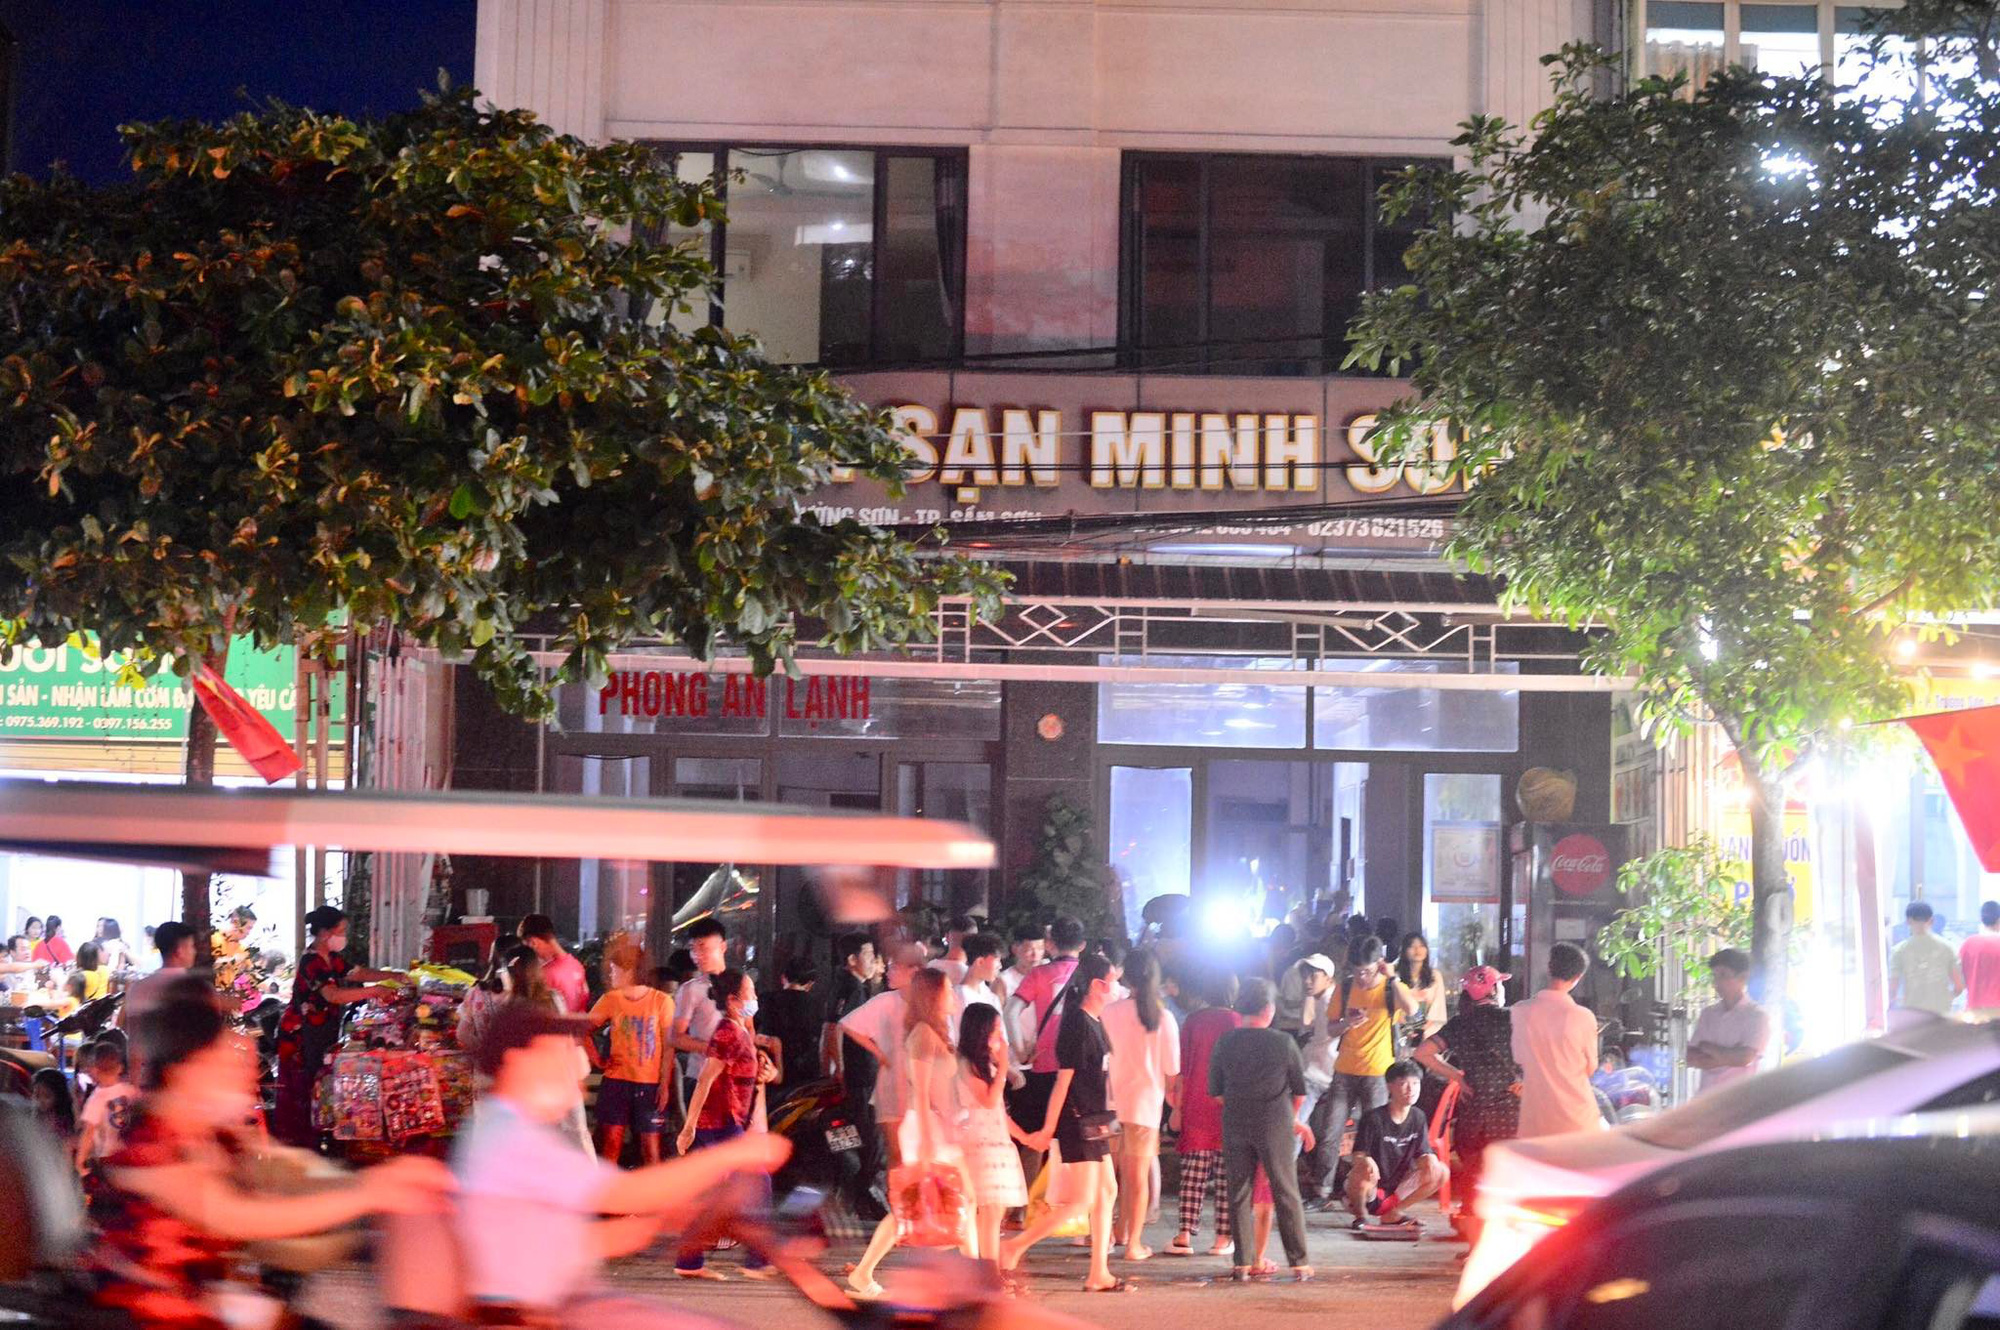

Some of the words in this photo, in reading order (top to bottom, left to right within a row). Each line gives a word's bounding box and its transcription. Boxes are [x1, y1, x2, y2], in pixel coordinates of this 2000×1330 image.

[888, 404, 1062, 503] SẠN
[1090, 410, 1320, 493] MINH
[51, 681, 98, 711] NHẬN
[785, 675, 871, 729] LẠNH
[1550, 854, 1609, 873] Coca-Cola
